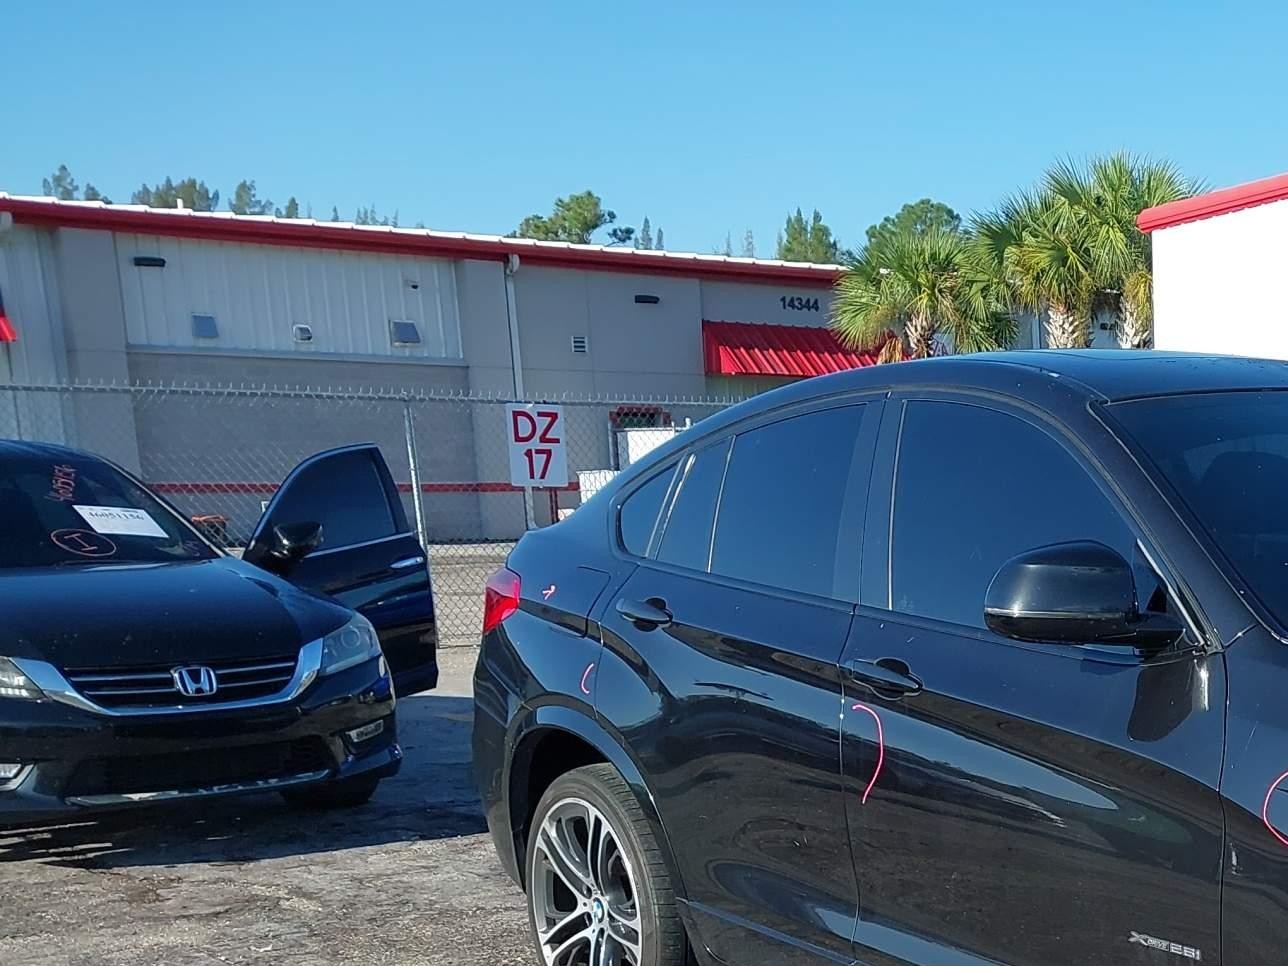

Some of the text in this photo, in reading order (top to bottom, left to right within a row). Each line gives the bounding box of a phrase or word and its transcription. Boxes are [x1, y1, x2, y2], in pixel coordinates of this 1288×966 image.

[780, 296, 819, 312] 14344
[512, 410, 560, 443] DZ
[524, 448, 552, 480] 17
